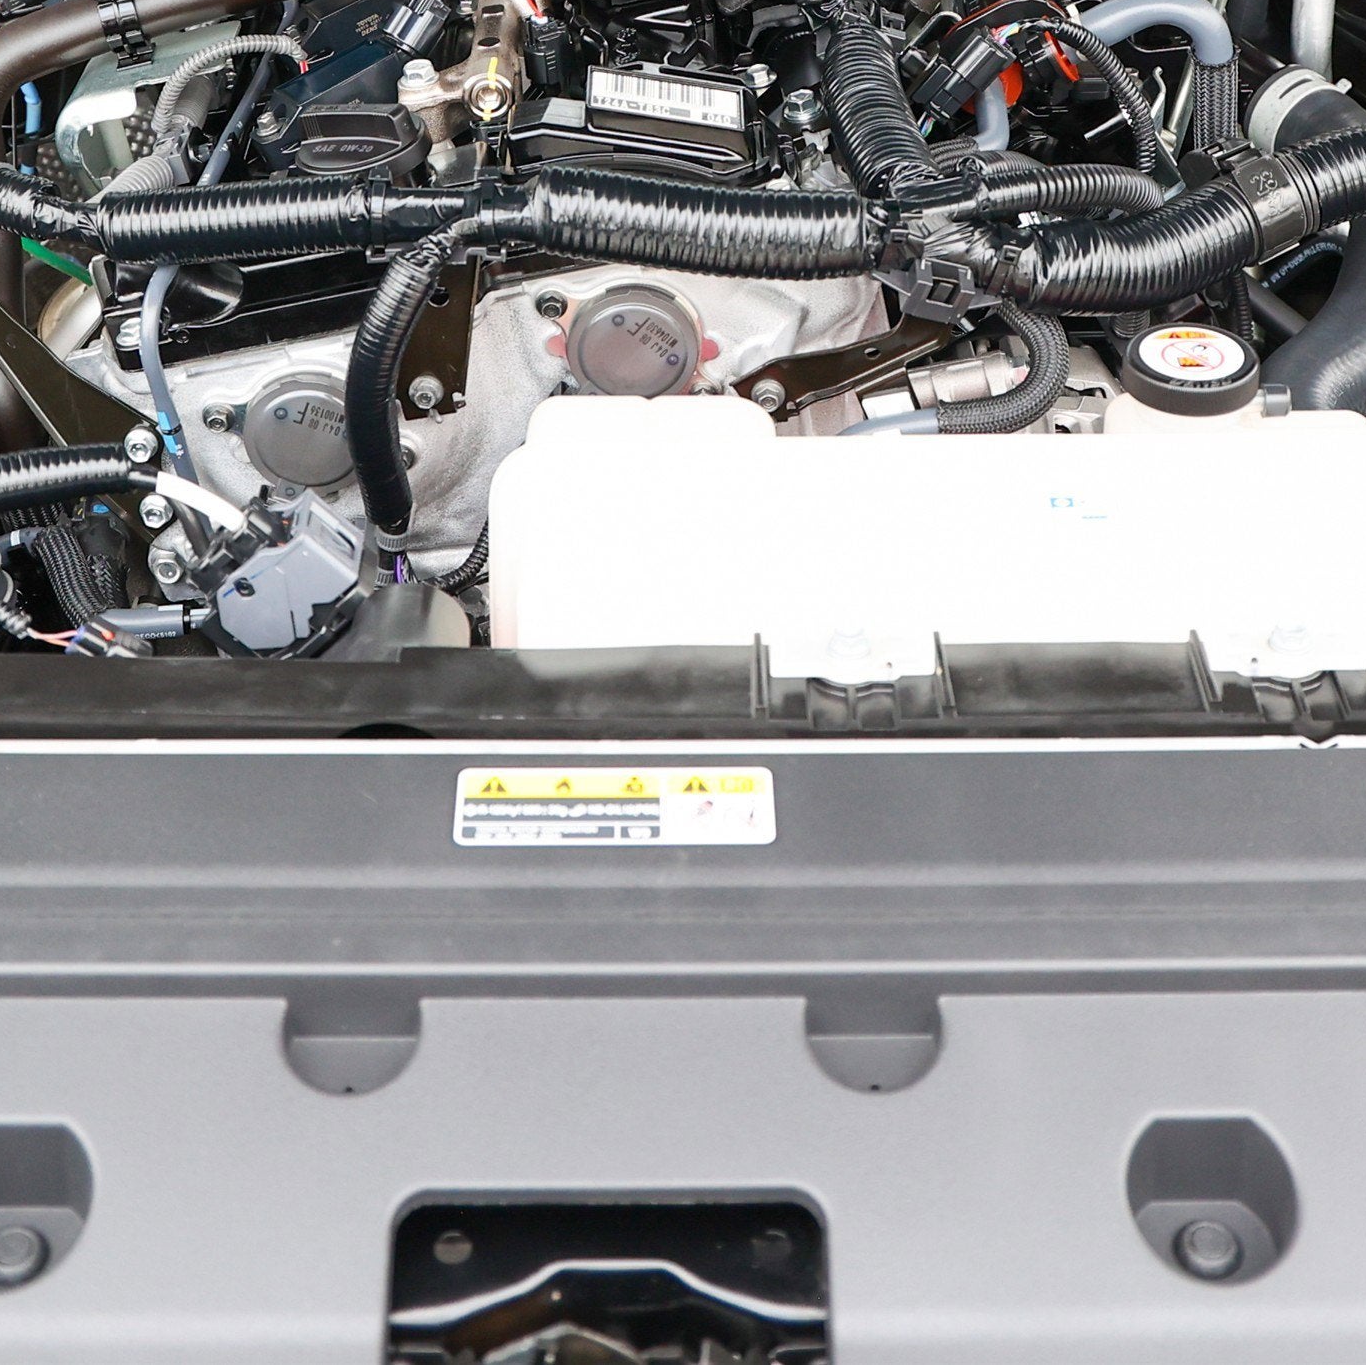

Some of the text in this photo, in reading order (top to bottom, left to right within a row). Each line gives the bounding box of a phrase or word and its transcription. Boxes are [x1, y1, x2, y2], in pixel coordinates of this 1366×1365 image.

[312, 144, 375, 153] SAE 0W-20
[627, 317, 650, 337] F
[292, 401, 310, 425] F
